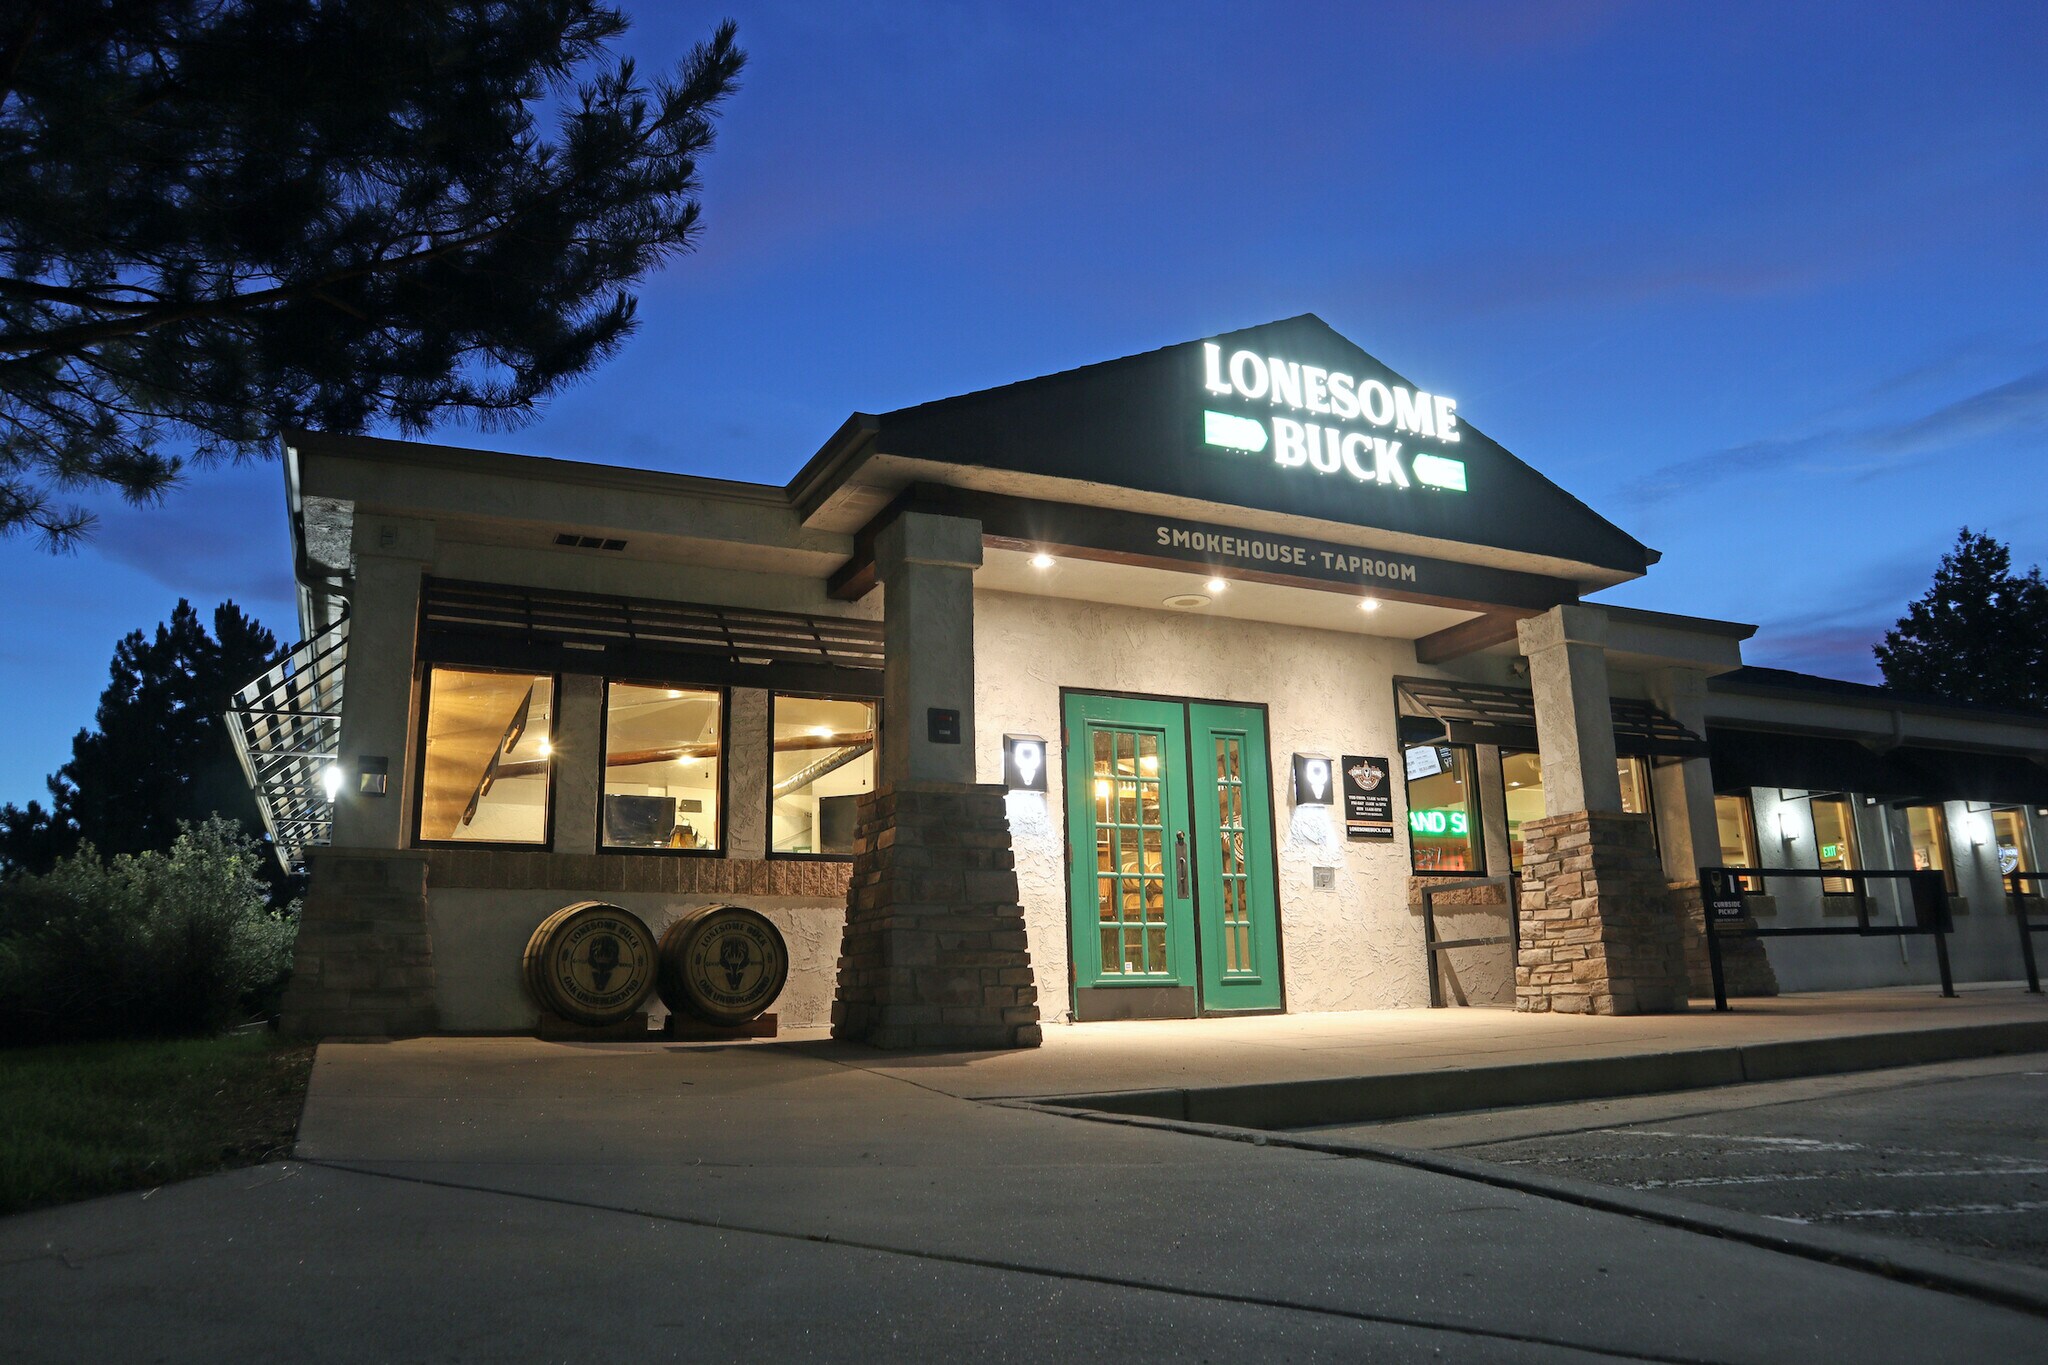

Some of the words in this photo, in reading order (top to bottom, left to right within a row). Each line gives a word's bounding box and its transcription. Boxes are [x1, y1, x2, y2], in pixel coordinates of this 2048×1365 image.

[1204, 342, 1461, 442] LONESOME
[1271, 416, 1411, 488] BUCK
[1156, 526, 1307, 567] SMOKEHOUSE
[1320, 551, 1417, 583] TAPROOM
[1822, 845, 1836, 858] EXIT
[570, 920, 617, 944] LONESOME
[619, 925, 640, 949] BUCK
[701, 922, 745, 948] LONESOME
